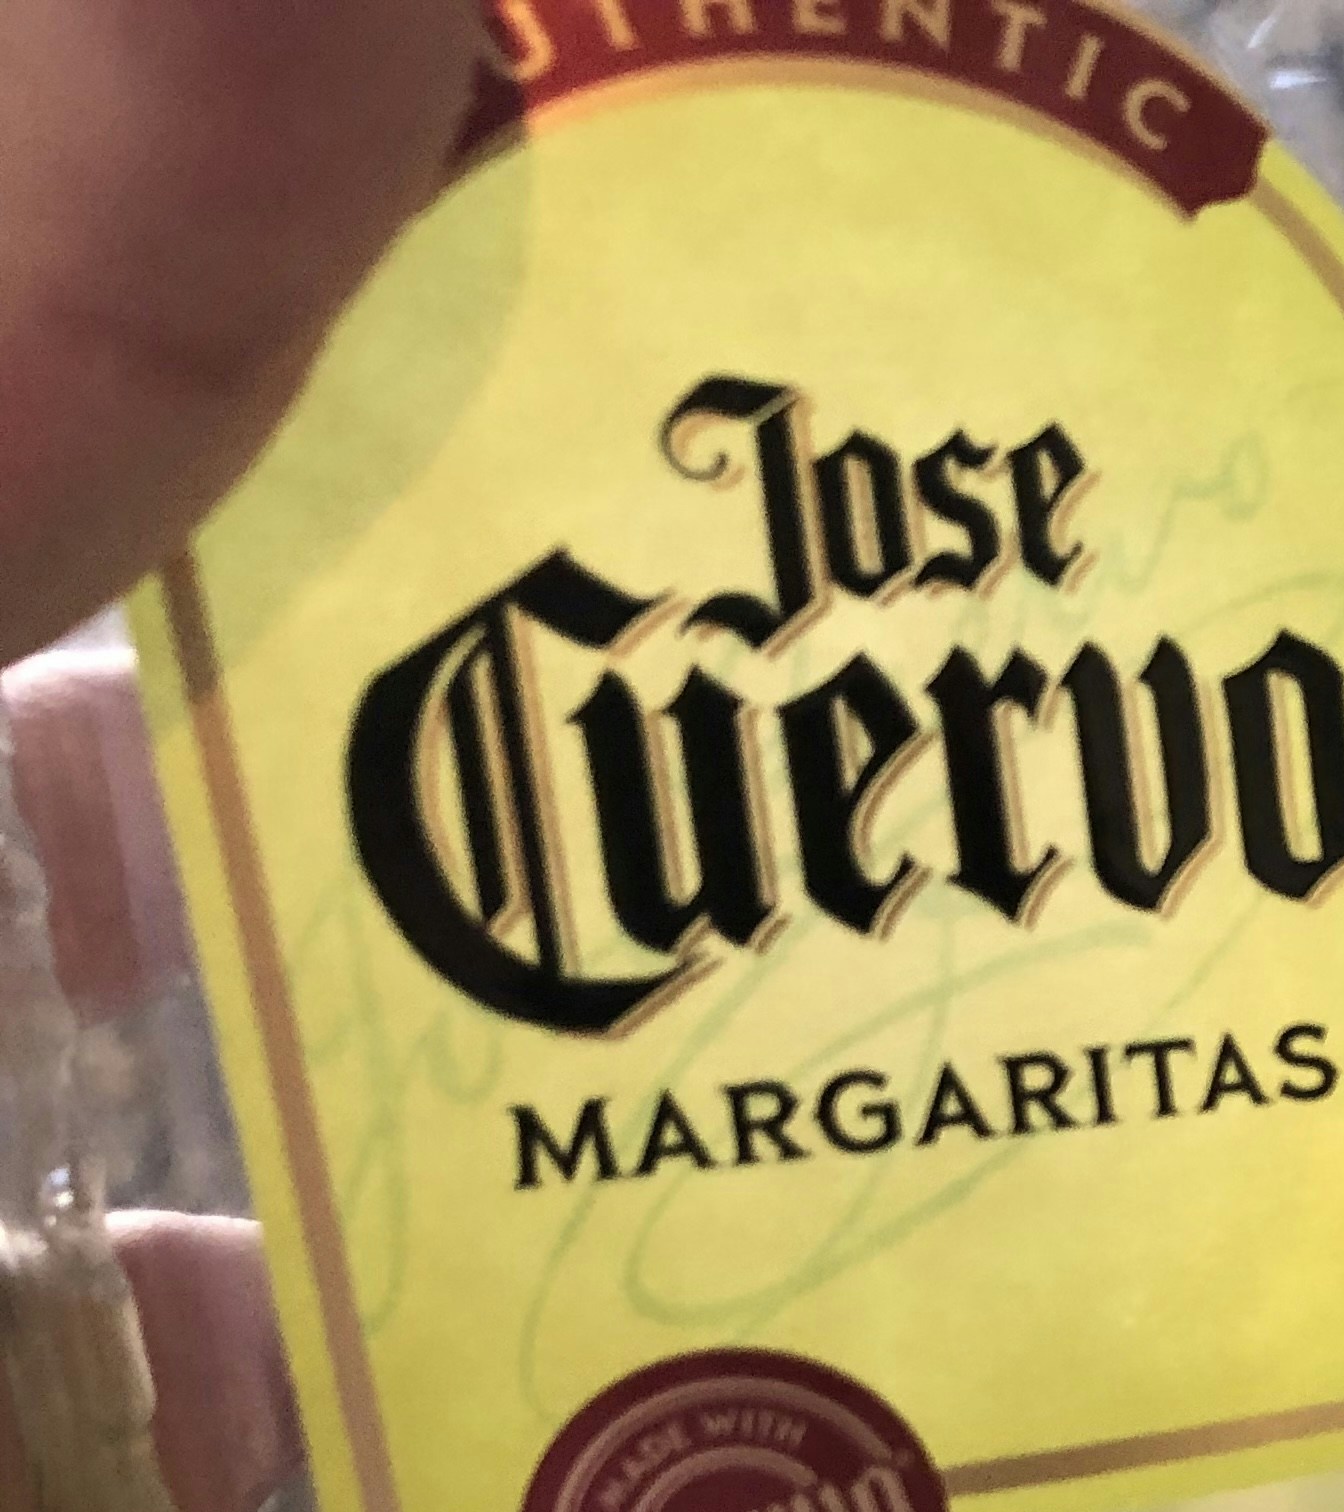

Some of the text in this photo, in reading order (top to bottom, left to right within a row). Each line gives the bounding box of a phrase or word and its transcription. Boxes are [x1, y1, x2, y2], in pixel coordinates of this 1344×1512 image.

[495, 0, 1192, 151] UTHENTIC
[657, 371, 1092, 654] Jose
[506, 1022, 1342, 1191] MARGARITAS
